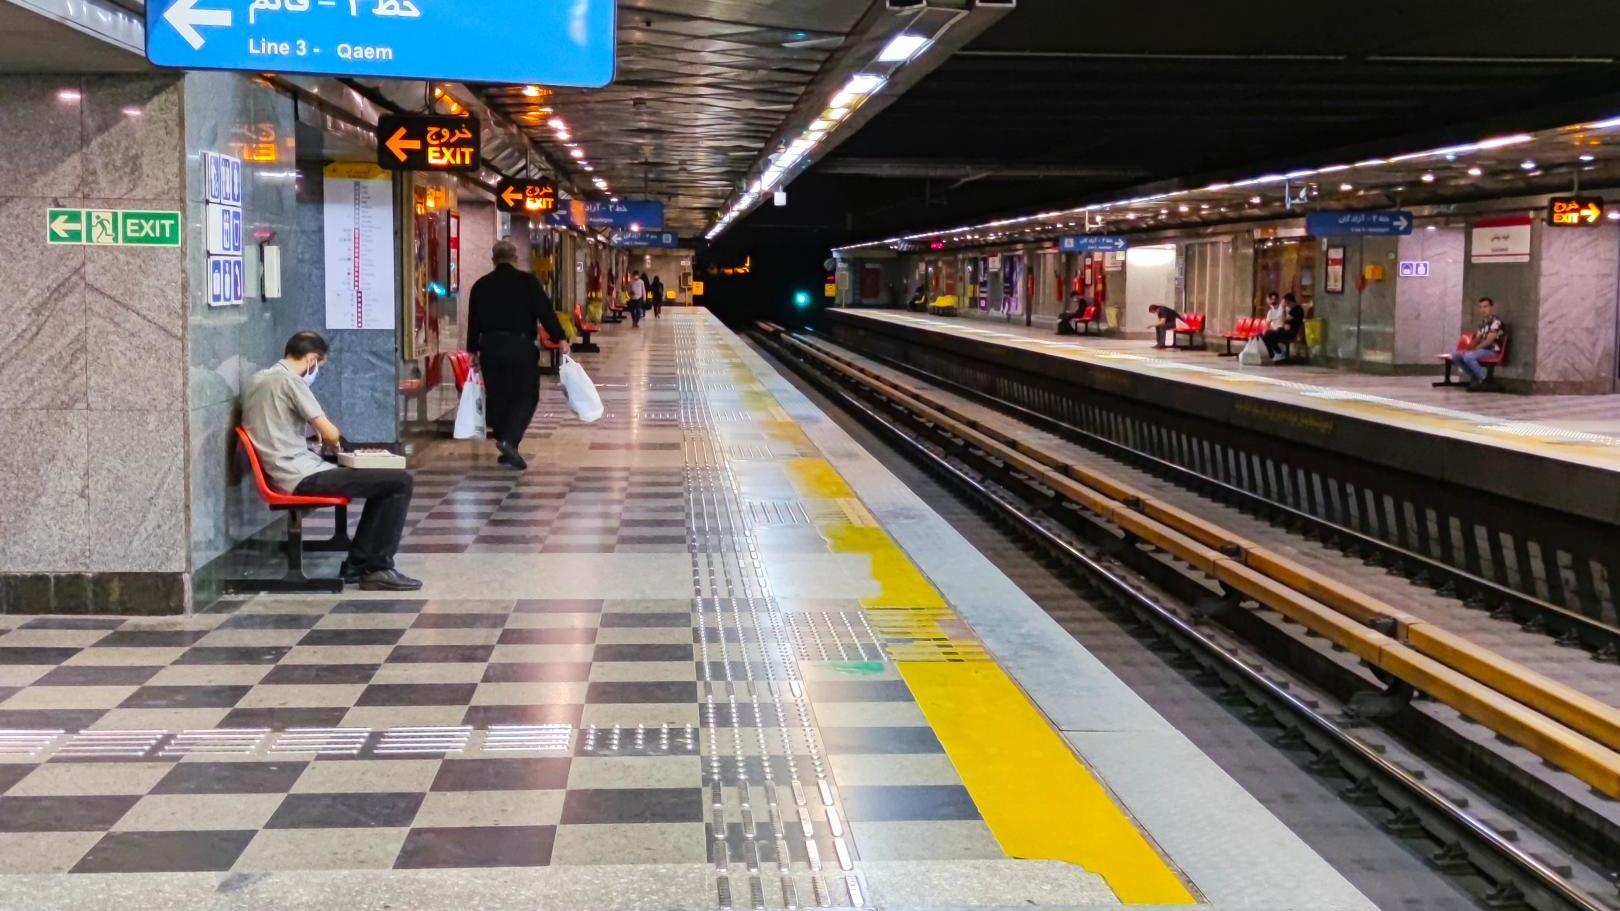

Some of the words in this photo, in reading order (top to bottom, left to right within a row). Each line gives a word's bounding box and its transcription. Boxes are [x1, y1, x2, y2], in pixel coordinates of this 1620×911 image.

[249, 38, 289, 55] Line
[296, 39, 306, 56] 3
[336, 43, 393, 60] Qaem
[426, 124, 473, 145] خروج
[427, 147, 474, 165] EXIT
[525, 184, 553, 197] خروج
[525, 197, 554, 210] EXIT
[1553, 212, 1580, 224] EXIT
[126, 219, 175, 238] EXIT
